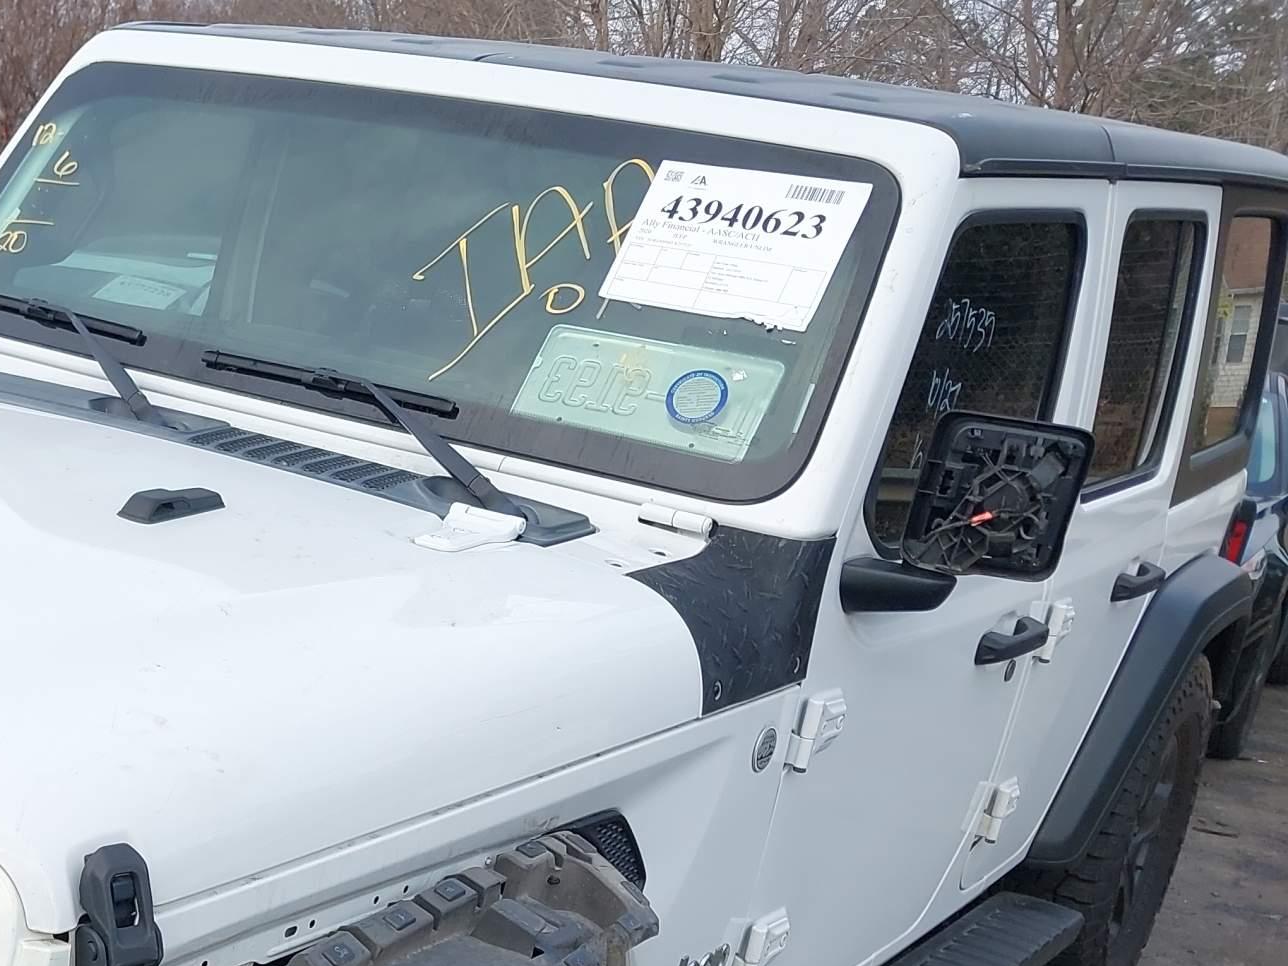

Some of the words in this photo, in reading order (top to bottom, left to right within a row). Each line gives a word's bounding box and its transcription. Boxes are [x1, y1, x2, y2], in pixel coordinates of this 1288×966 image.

[641, 218, 662, 229] Ally
[662, 220, 701, 233] Financial
[661, 195, 827, 240] 43940623
